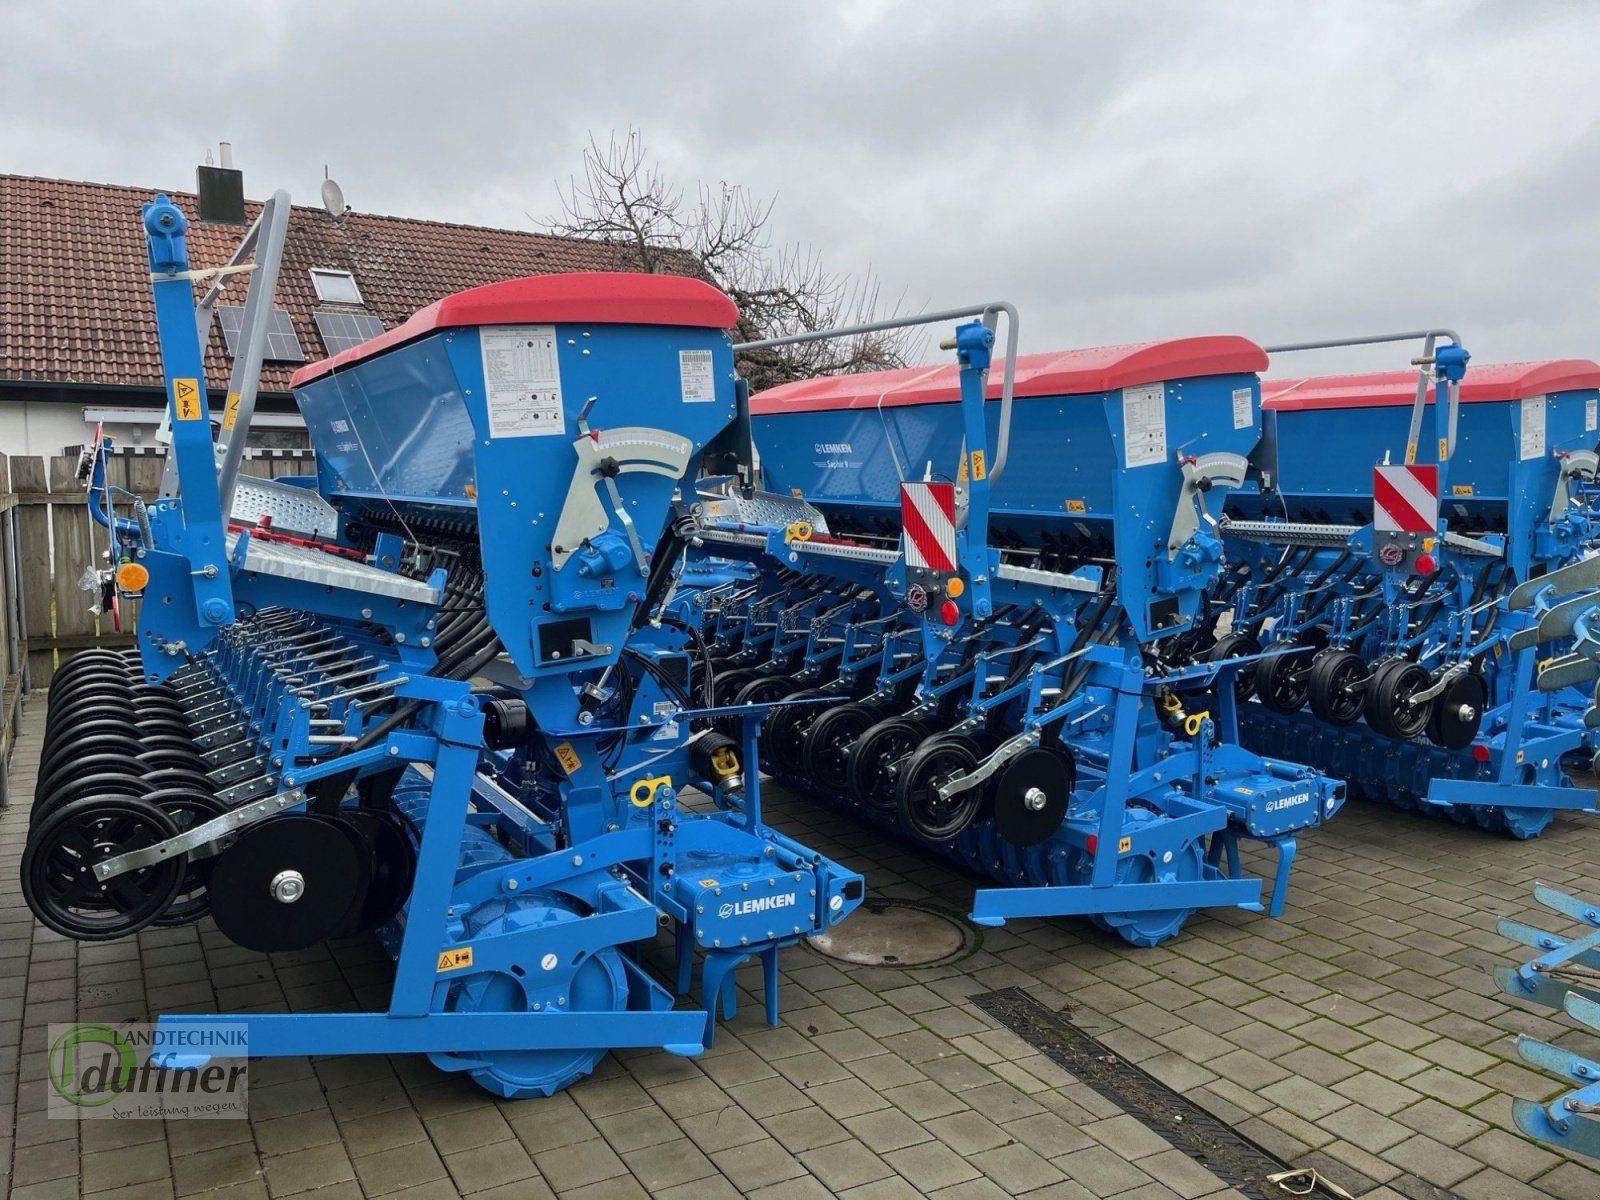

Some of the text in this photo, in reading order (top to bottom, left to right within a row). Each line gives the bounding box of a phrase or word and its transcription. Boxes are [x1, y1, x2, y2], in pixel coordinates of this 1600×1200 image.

[821, 443, 852, 453] LEMKEN
[1274, 793, 1309, 810] LEMKEN
[734, 892, 796, 915] LEMKEN
